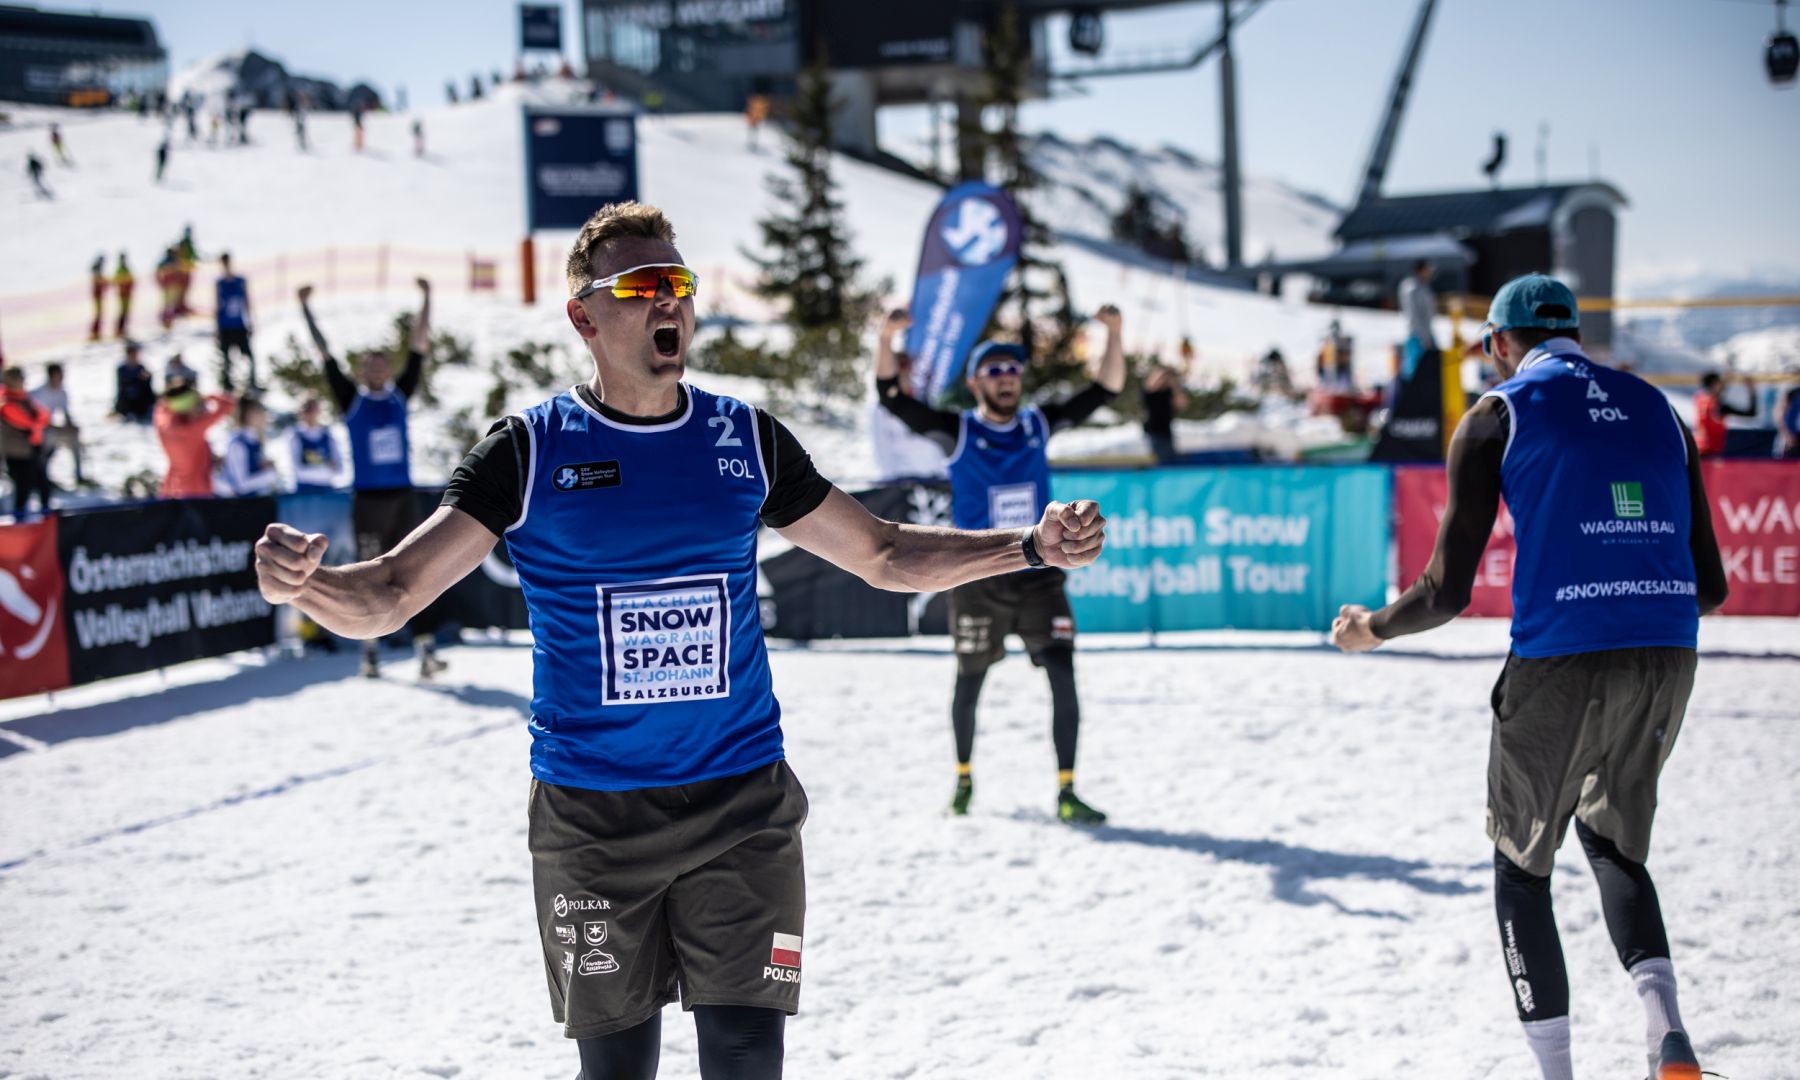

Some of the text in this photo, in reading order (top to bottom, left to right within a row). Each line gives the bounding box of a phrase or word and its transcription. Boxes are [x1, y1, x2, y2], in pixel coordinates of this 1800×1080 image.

[1586, 380, 1609, 402] 4
[1588, 407, 1629, 422] POL
[707, 415, 743, 447] 2
[718, 457, 755, 479] POL
[1717, 495, 1800, 535] WA
[1104, 507, 1310, 548] trian Snow
[1580, 519, 1676, 535] WAGRAIN BAU
[71, 538, 251, 593] Österreichischer
[1065, 554, 1310, 604] olleyball Tour
[620, 594, 713, 610] FLACHAU
[74, 592, 190, 649] Volleyball
[620, 607, 714, 633] SNOW
[622, 630, 714, 647] WAGRAIN
[623, 644, 714, 669] SPACE
[623, 667, 714, 684] ST. JOHANN
[623, 685, 714, 700] SALZBURG
[568, 899, 611, 911] POLKAR
